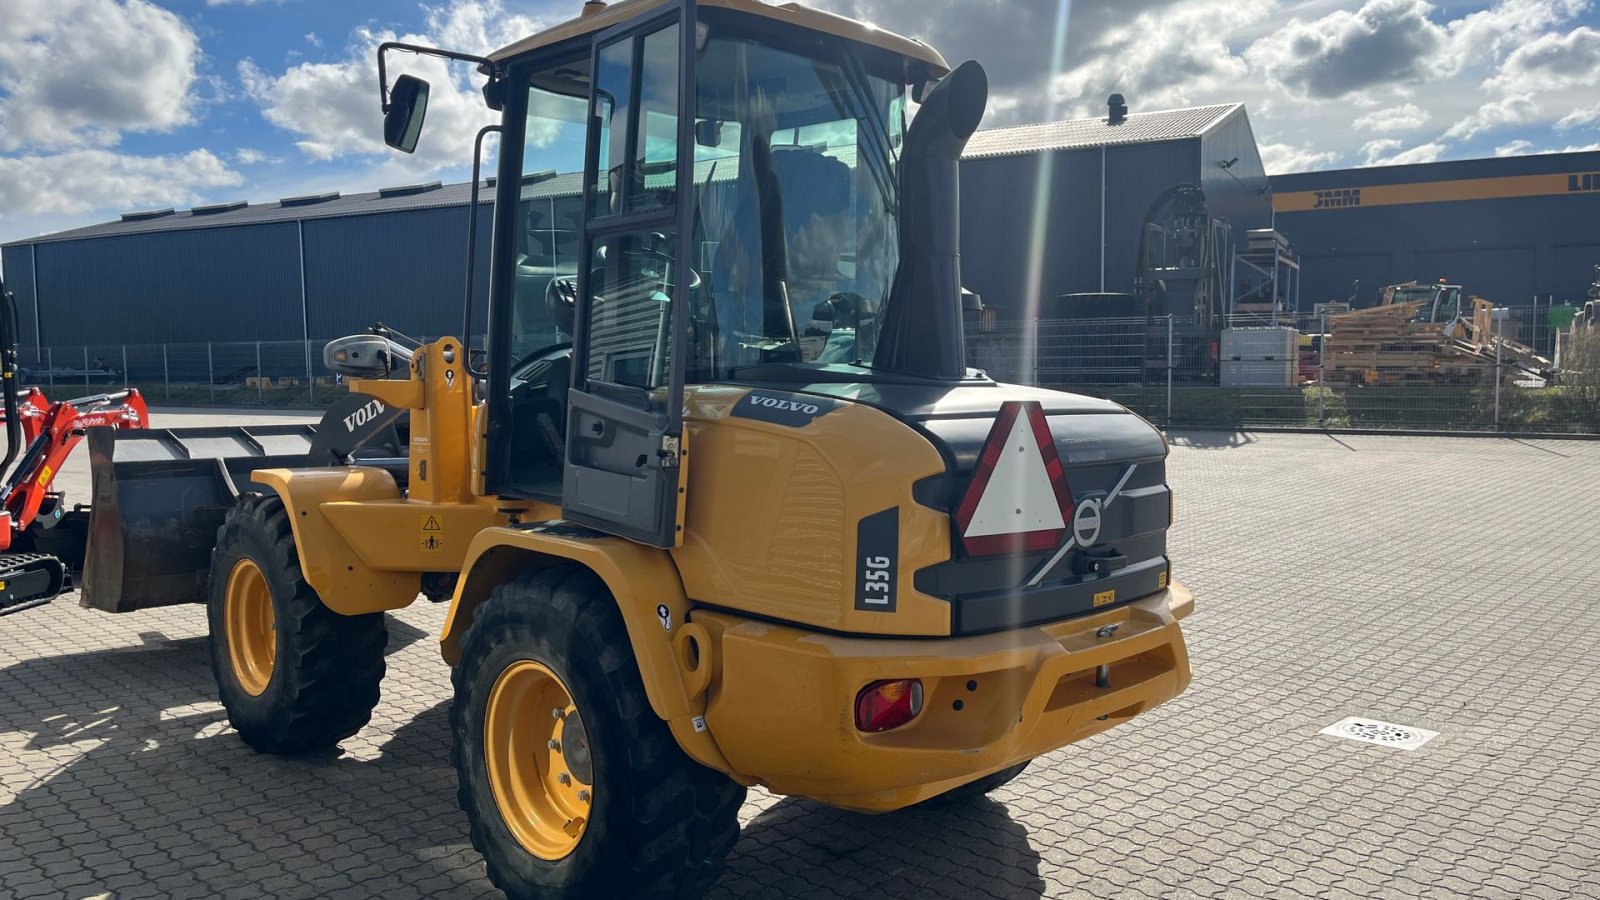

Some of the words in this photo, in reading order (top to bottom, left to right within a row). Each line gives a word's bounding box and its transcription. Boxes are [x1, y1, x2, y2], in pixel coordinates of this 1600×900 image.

[343, 399, 385, 433] VOLV
[750, 395, 819, 414] VOLVO
[864, 556, 890, 605] L35G
